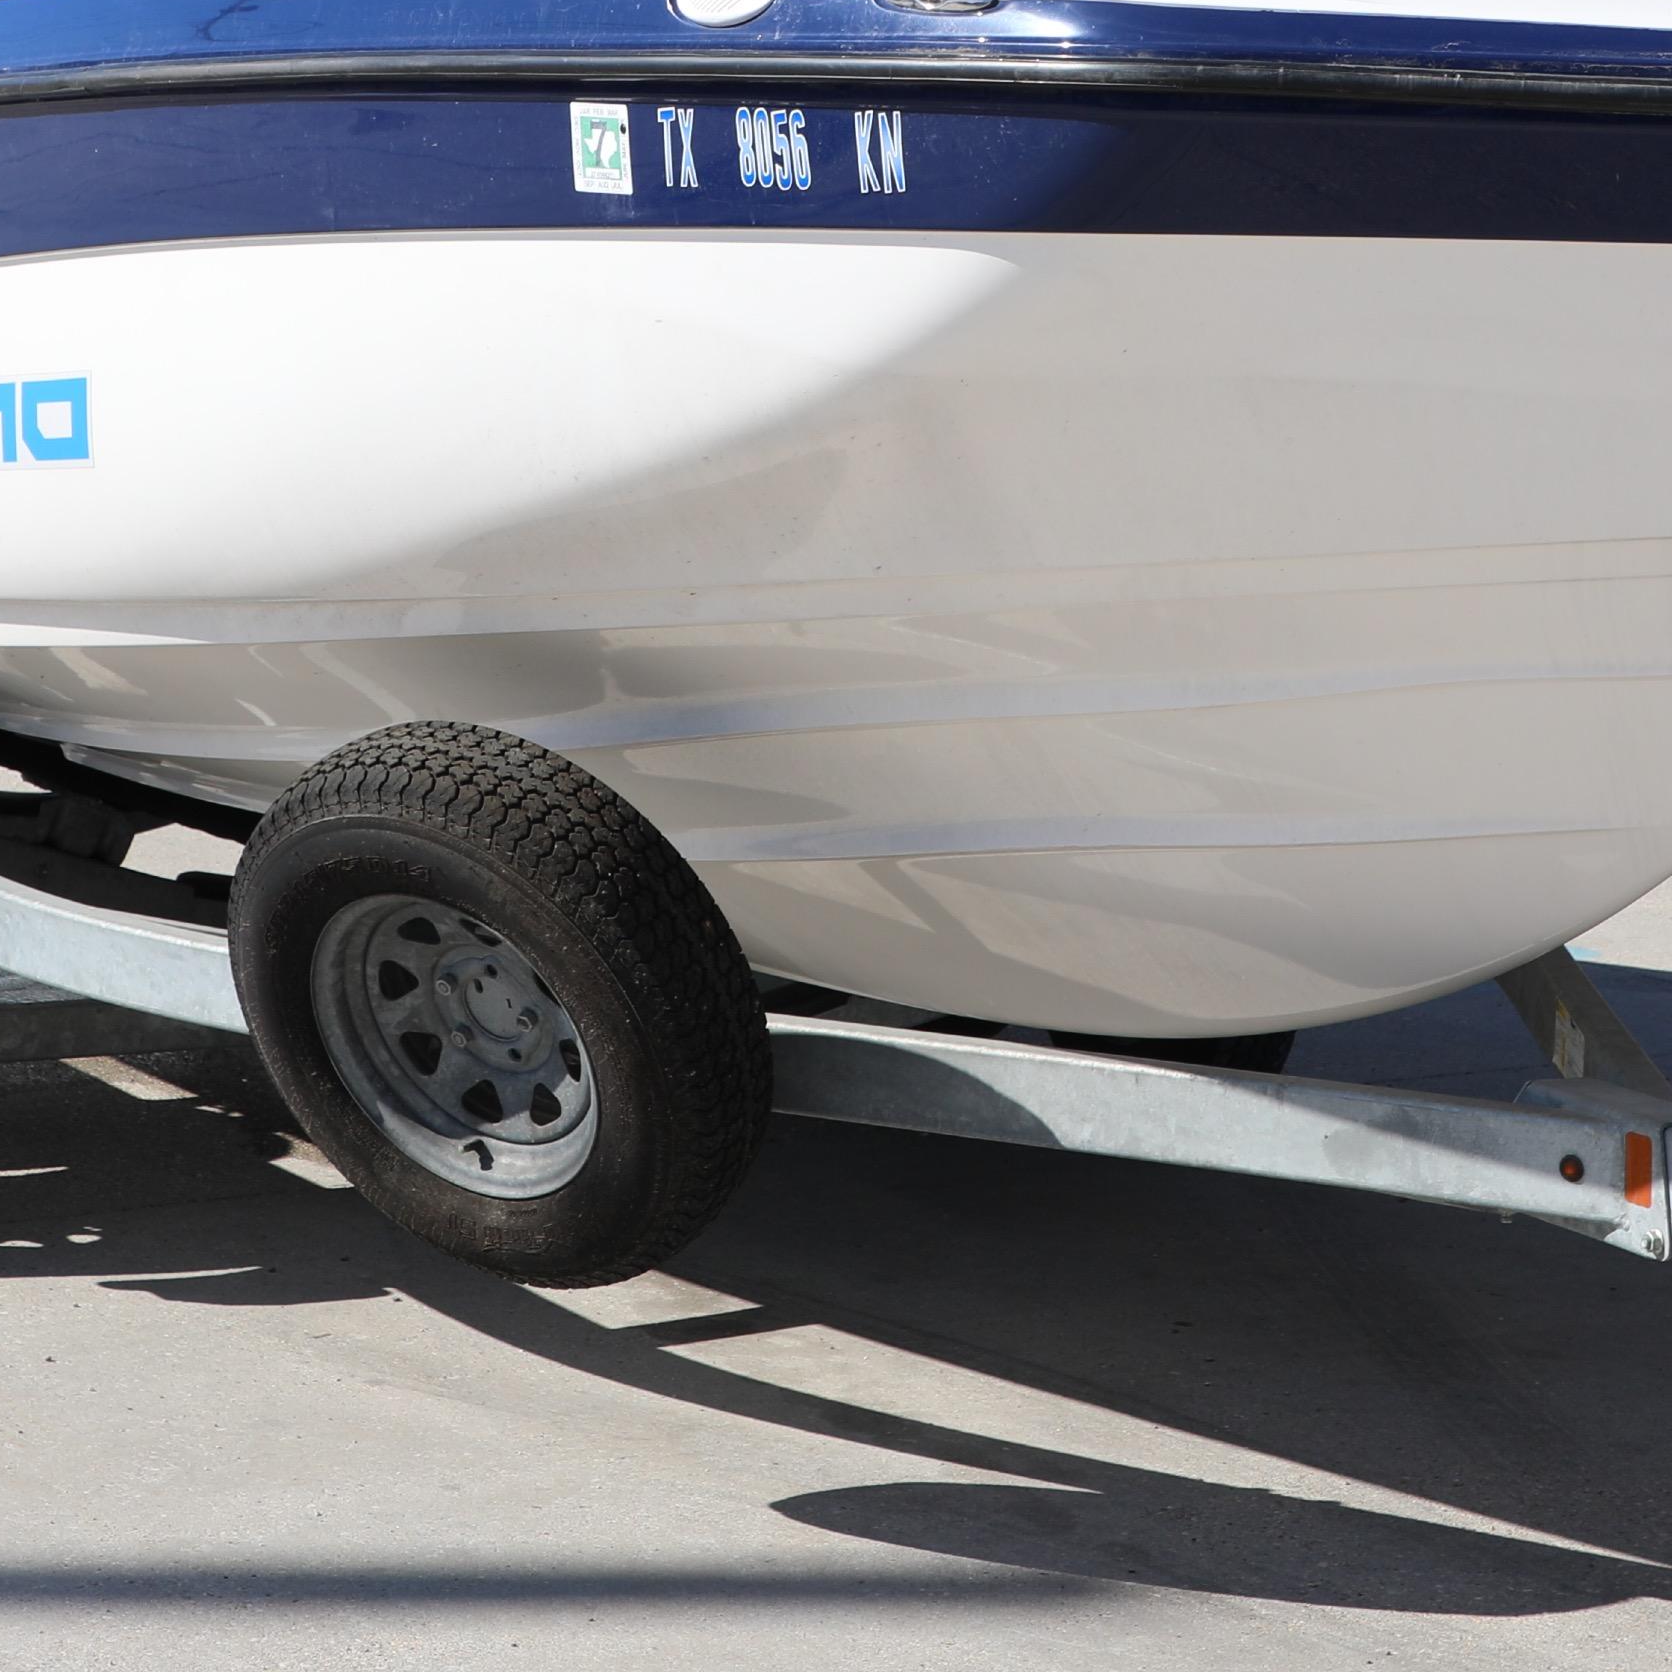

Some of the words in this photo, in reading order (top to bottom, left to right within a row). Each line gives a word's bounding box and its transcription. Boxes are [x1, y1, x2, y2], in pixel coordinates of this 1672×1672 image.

[657, 107, 699, 188] TX
[735, 107, 811, 191] 8056
[854, 110, 906, 194] KN
